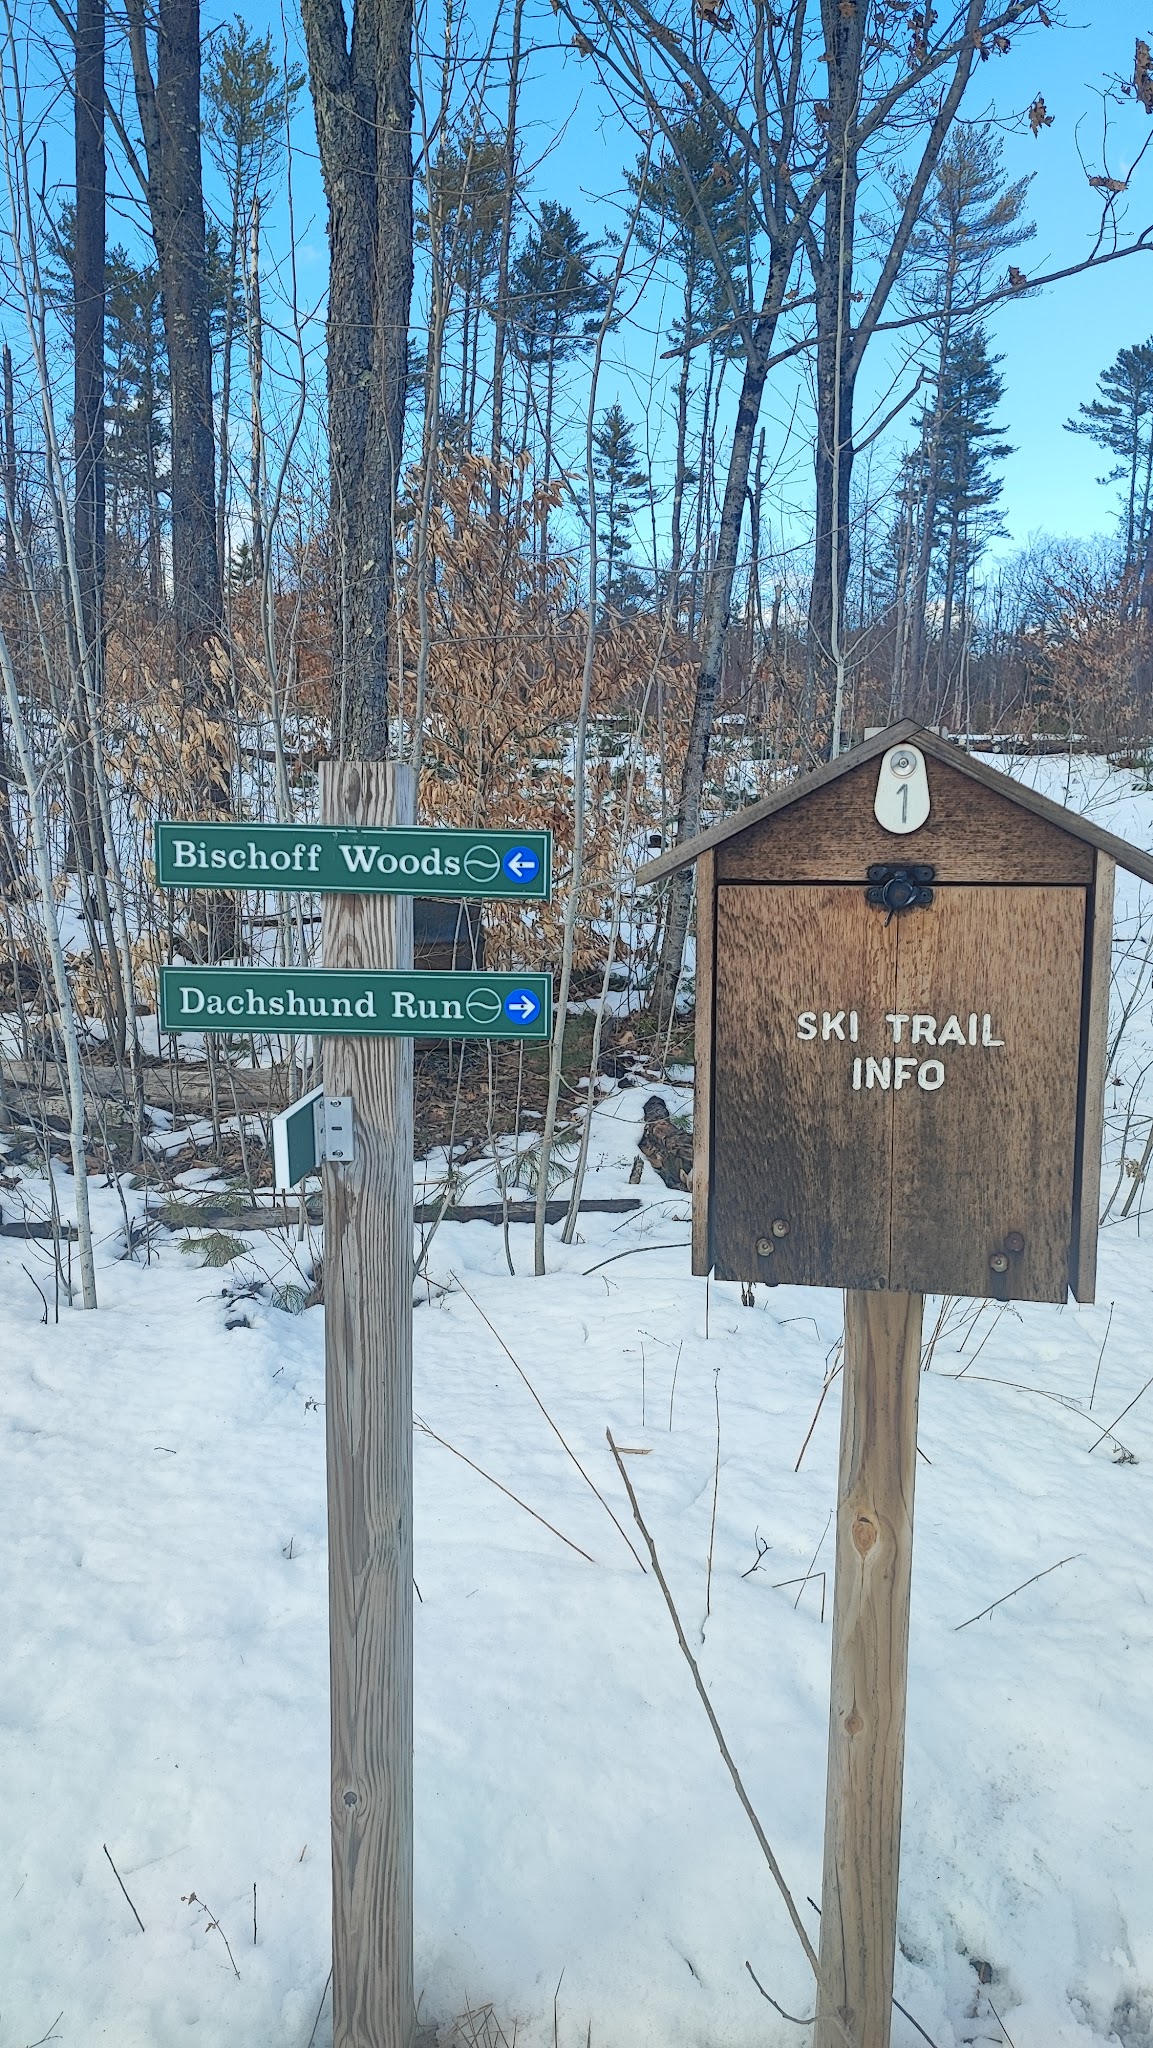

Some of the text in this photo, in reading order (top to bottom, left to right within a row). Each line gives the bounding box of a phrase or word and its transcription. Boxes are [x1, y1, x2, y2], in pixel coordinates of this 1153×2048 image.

[896, 783, 909, 824] 1
[172, 840, 461, 876] Bischoff Woods
[179, 986, 465, 1021] Dachshund Run
[797, 1010, 1005, 1047] SKI TRAIL
[852, 1056, 945, 1091] INFO
